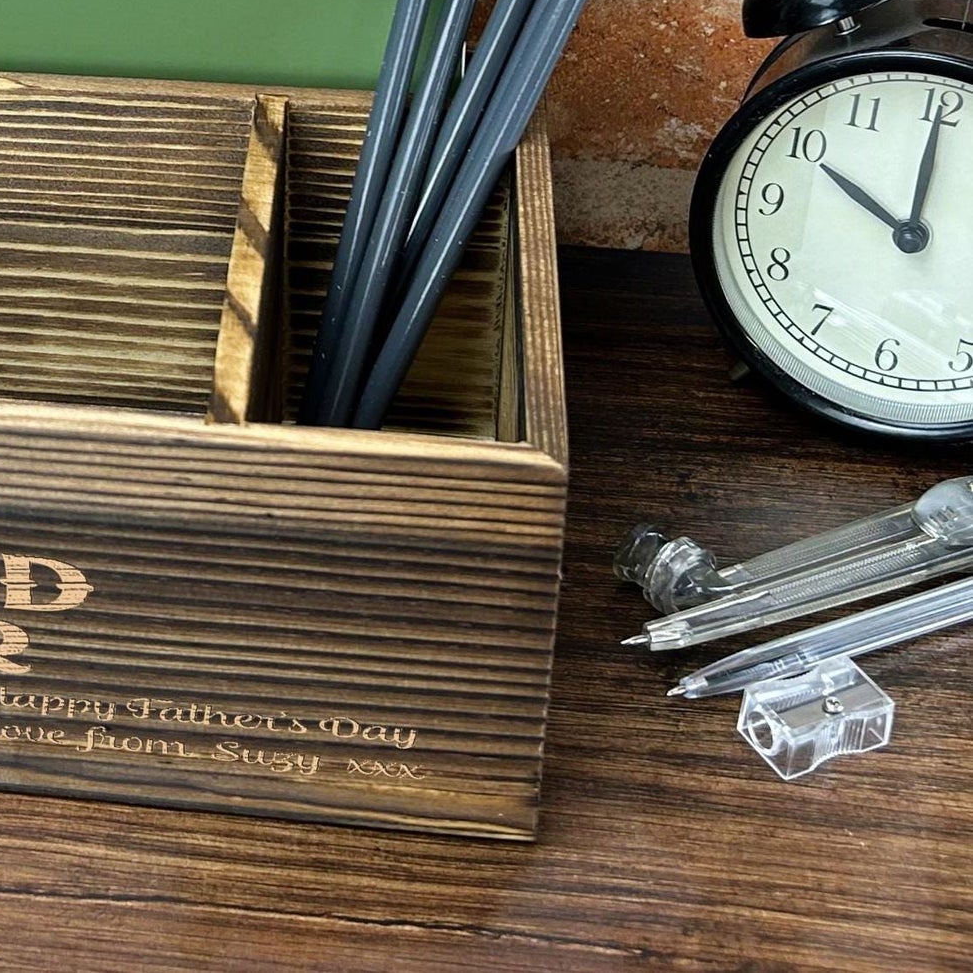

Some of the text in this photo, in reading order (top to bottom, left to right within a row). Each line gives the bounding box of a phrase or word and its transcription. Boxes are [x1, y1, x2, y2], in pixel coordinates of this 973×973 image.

[845, 92, 881, 133] 11
[918, 87, 964, 128] 12
[785, 126, 828, 164] 10
[758, 182, 785, 217] 9
[766, 247, 792, 282] 8
[811, 303, 835, 336] 7
[874, 337, 902, 372] 6
[948, 338, 973, 373] 5
[126, 697, 308, 735] Father's
[319, 716, 419, 749] Day
[76, 725, 195, 757] from
[211, 740, 321, 776] Suzy
[345, 758, 426, 781] xxx
